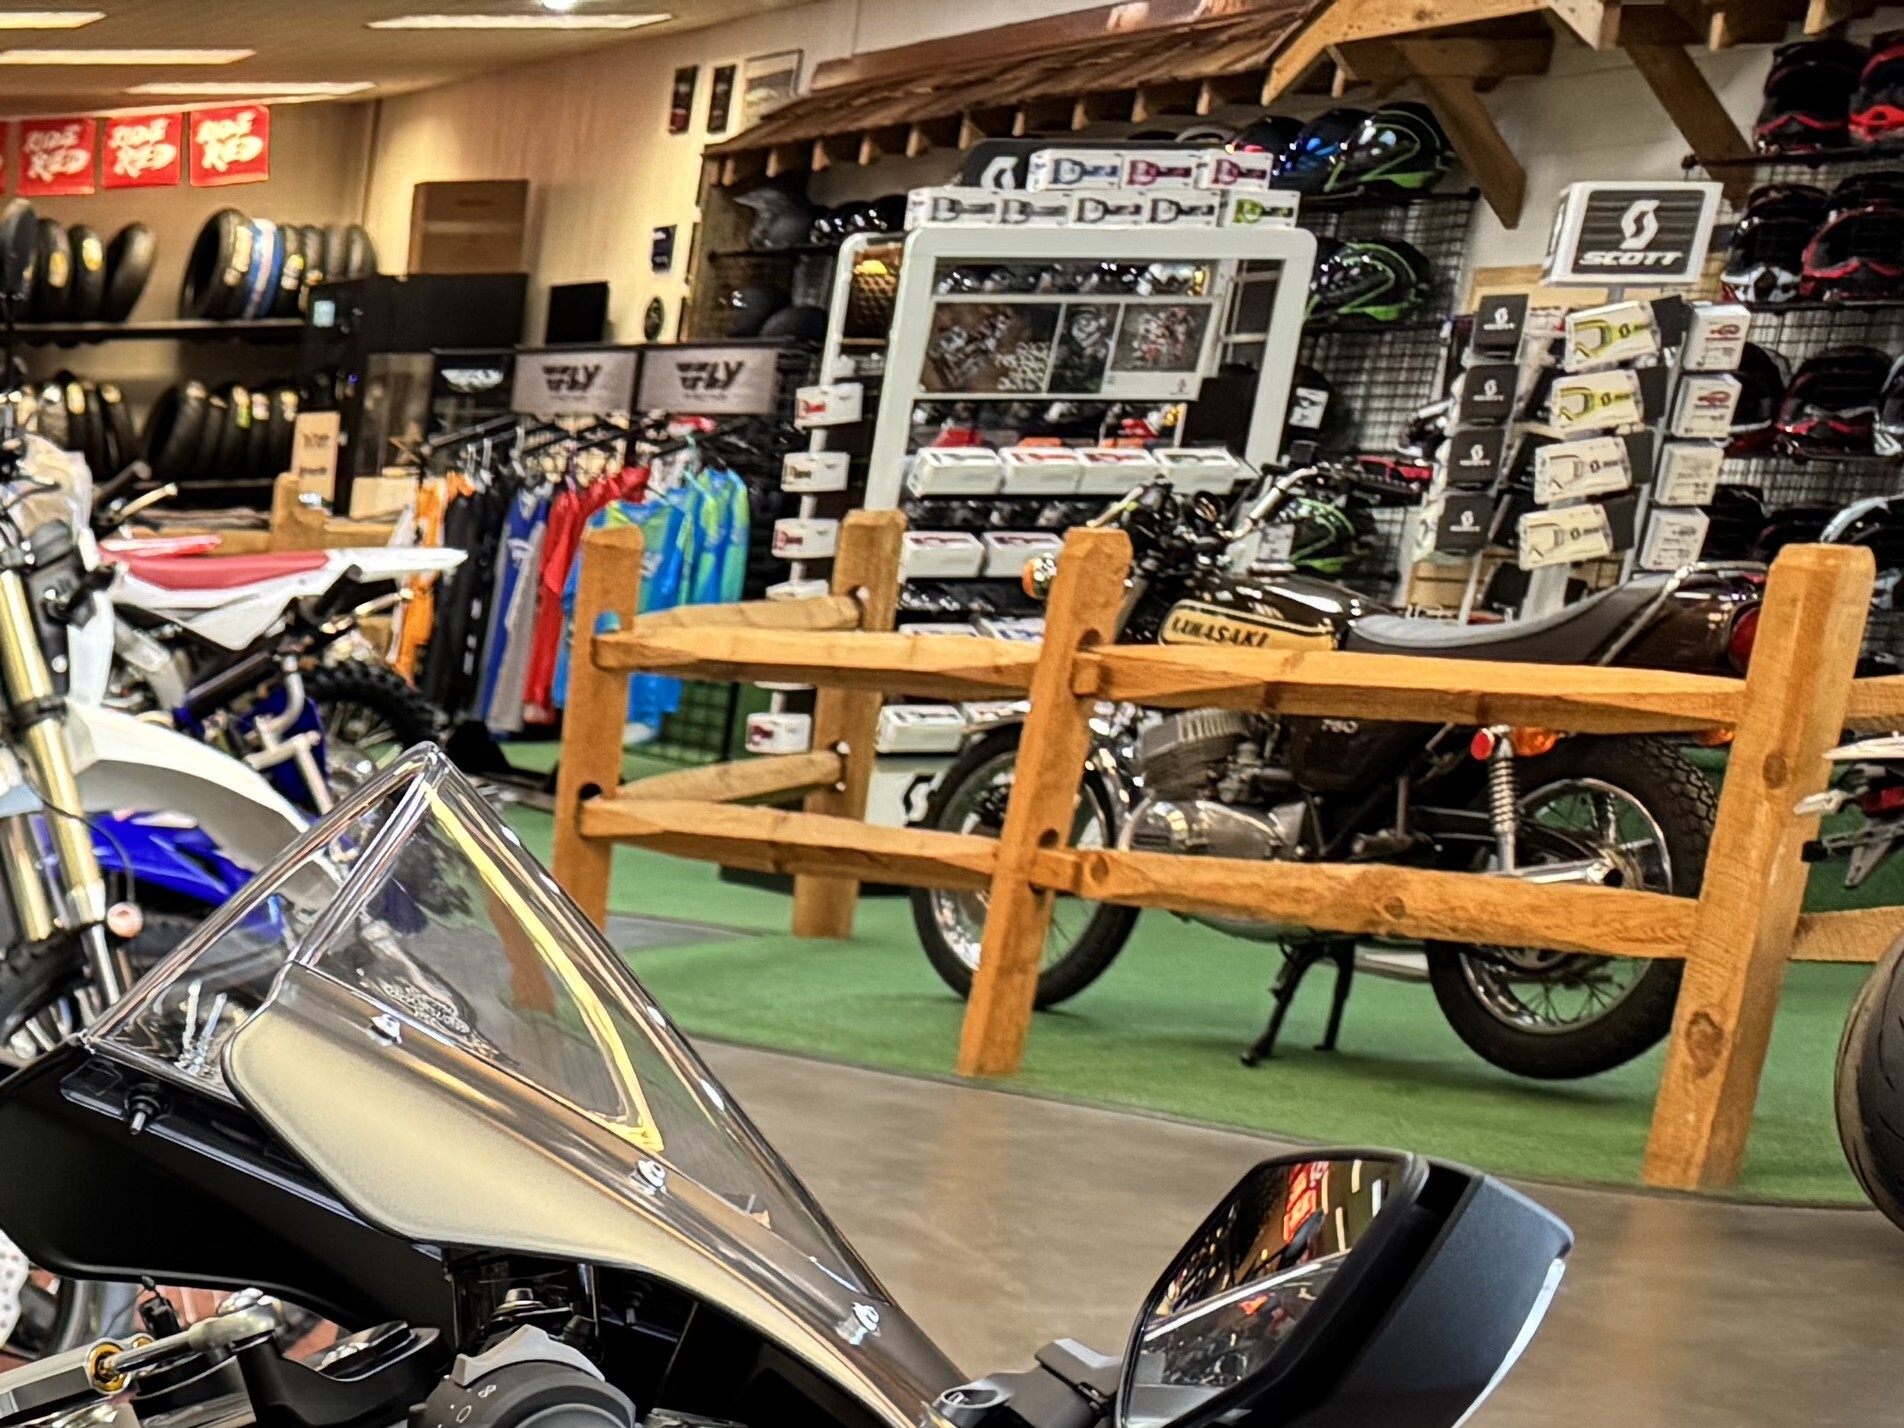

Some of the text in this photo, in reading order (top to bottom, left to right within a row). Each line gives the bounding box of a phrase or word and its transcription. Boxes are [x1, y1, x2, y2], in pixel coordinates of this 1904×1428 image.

[24, 124, 82, 152] RIDE
[110, 117, 170, 149] RIDE
[195, 111, 255, 144] RIDE
[28, 149, 90, 182] RED
[114, 143, 177, 178] RED
[201, 136, 264, 172] RED
[1579, 251, 1682, 266] SCOTT
[676, 360, 744, 391] FLY
